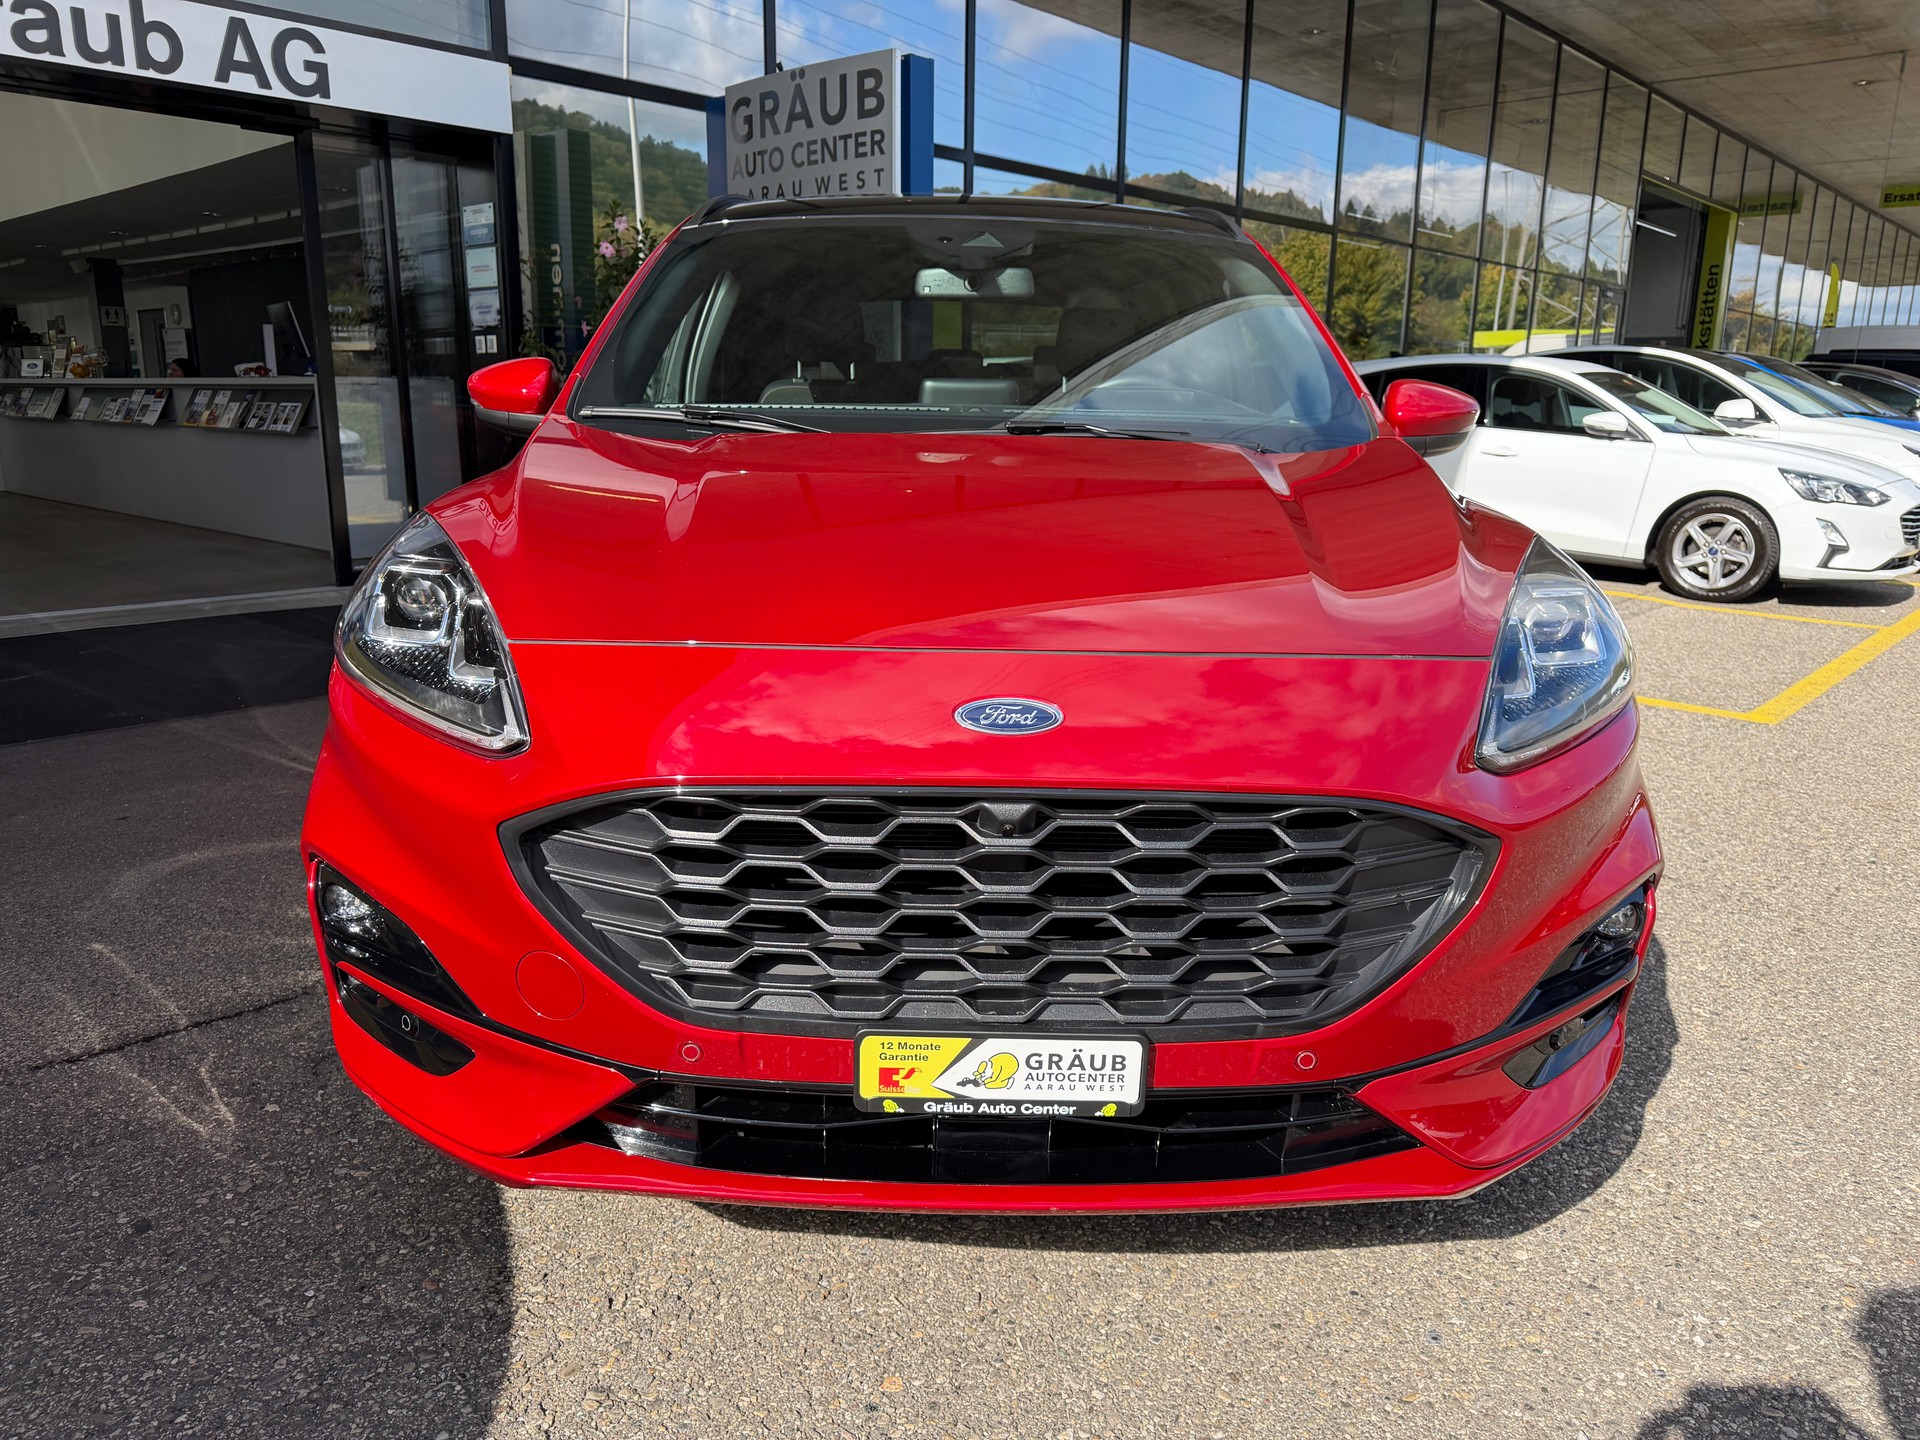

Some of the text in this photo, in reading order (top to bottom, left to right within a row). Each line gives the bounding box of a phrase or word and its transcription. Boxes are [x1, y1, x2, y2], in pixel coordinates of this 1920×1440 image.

[0, 0, 331, 99] aub AG
[731, 68, 885, 145] GRÄUB
[732, 129, 885, 181] AUTO CENTER
[736, 168, 885, 199] ARAU WEST
[980, 705, 1038, 724] Ford
[880, 1042, 941, 1051] 12 Monate
[879, 1053, 929, 1062] Garantie
[1025, 1048, 1127, 1072] GRÄUB
[1025, 1072, 1125, 1083] AUTOCENTER
[1086, 1084, 1125, 1092] WEST
[923, 1102, 1077, 1115] Gräub Auto Center
